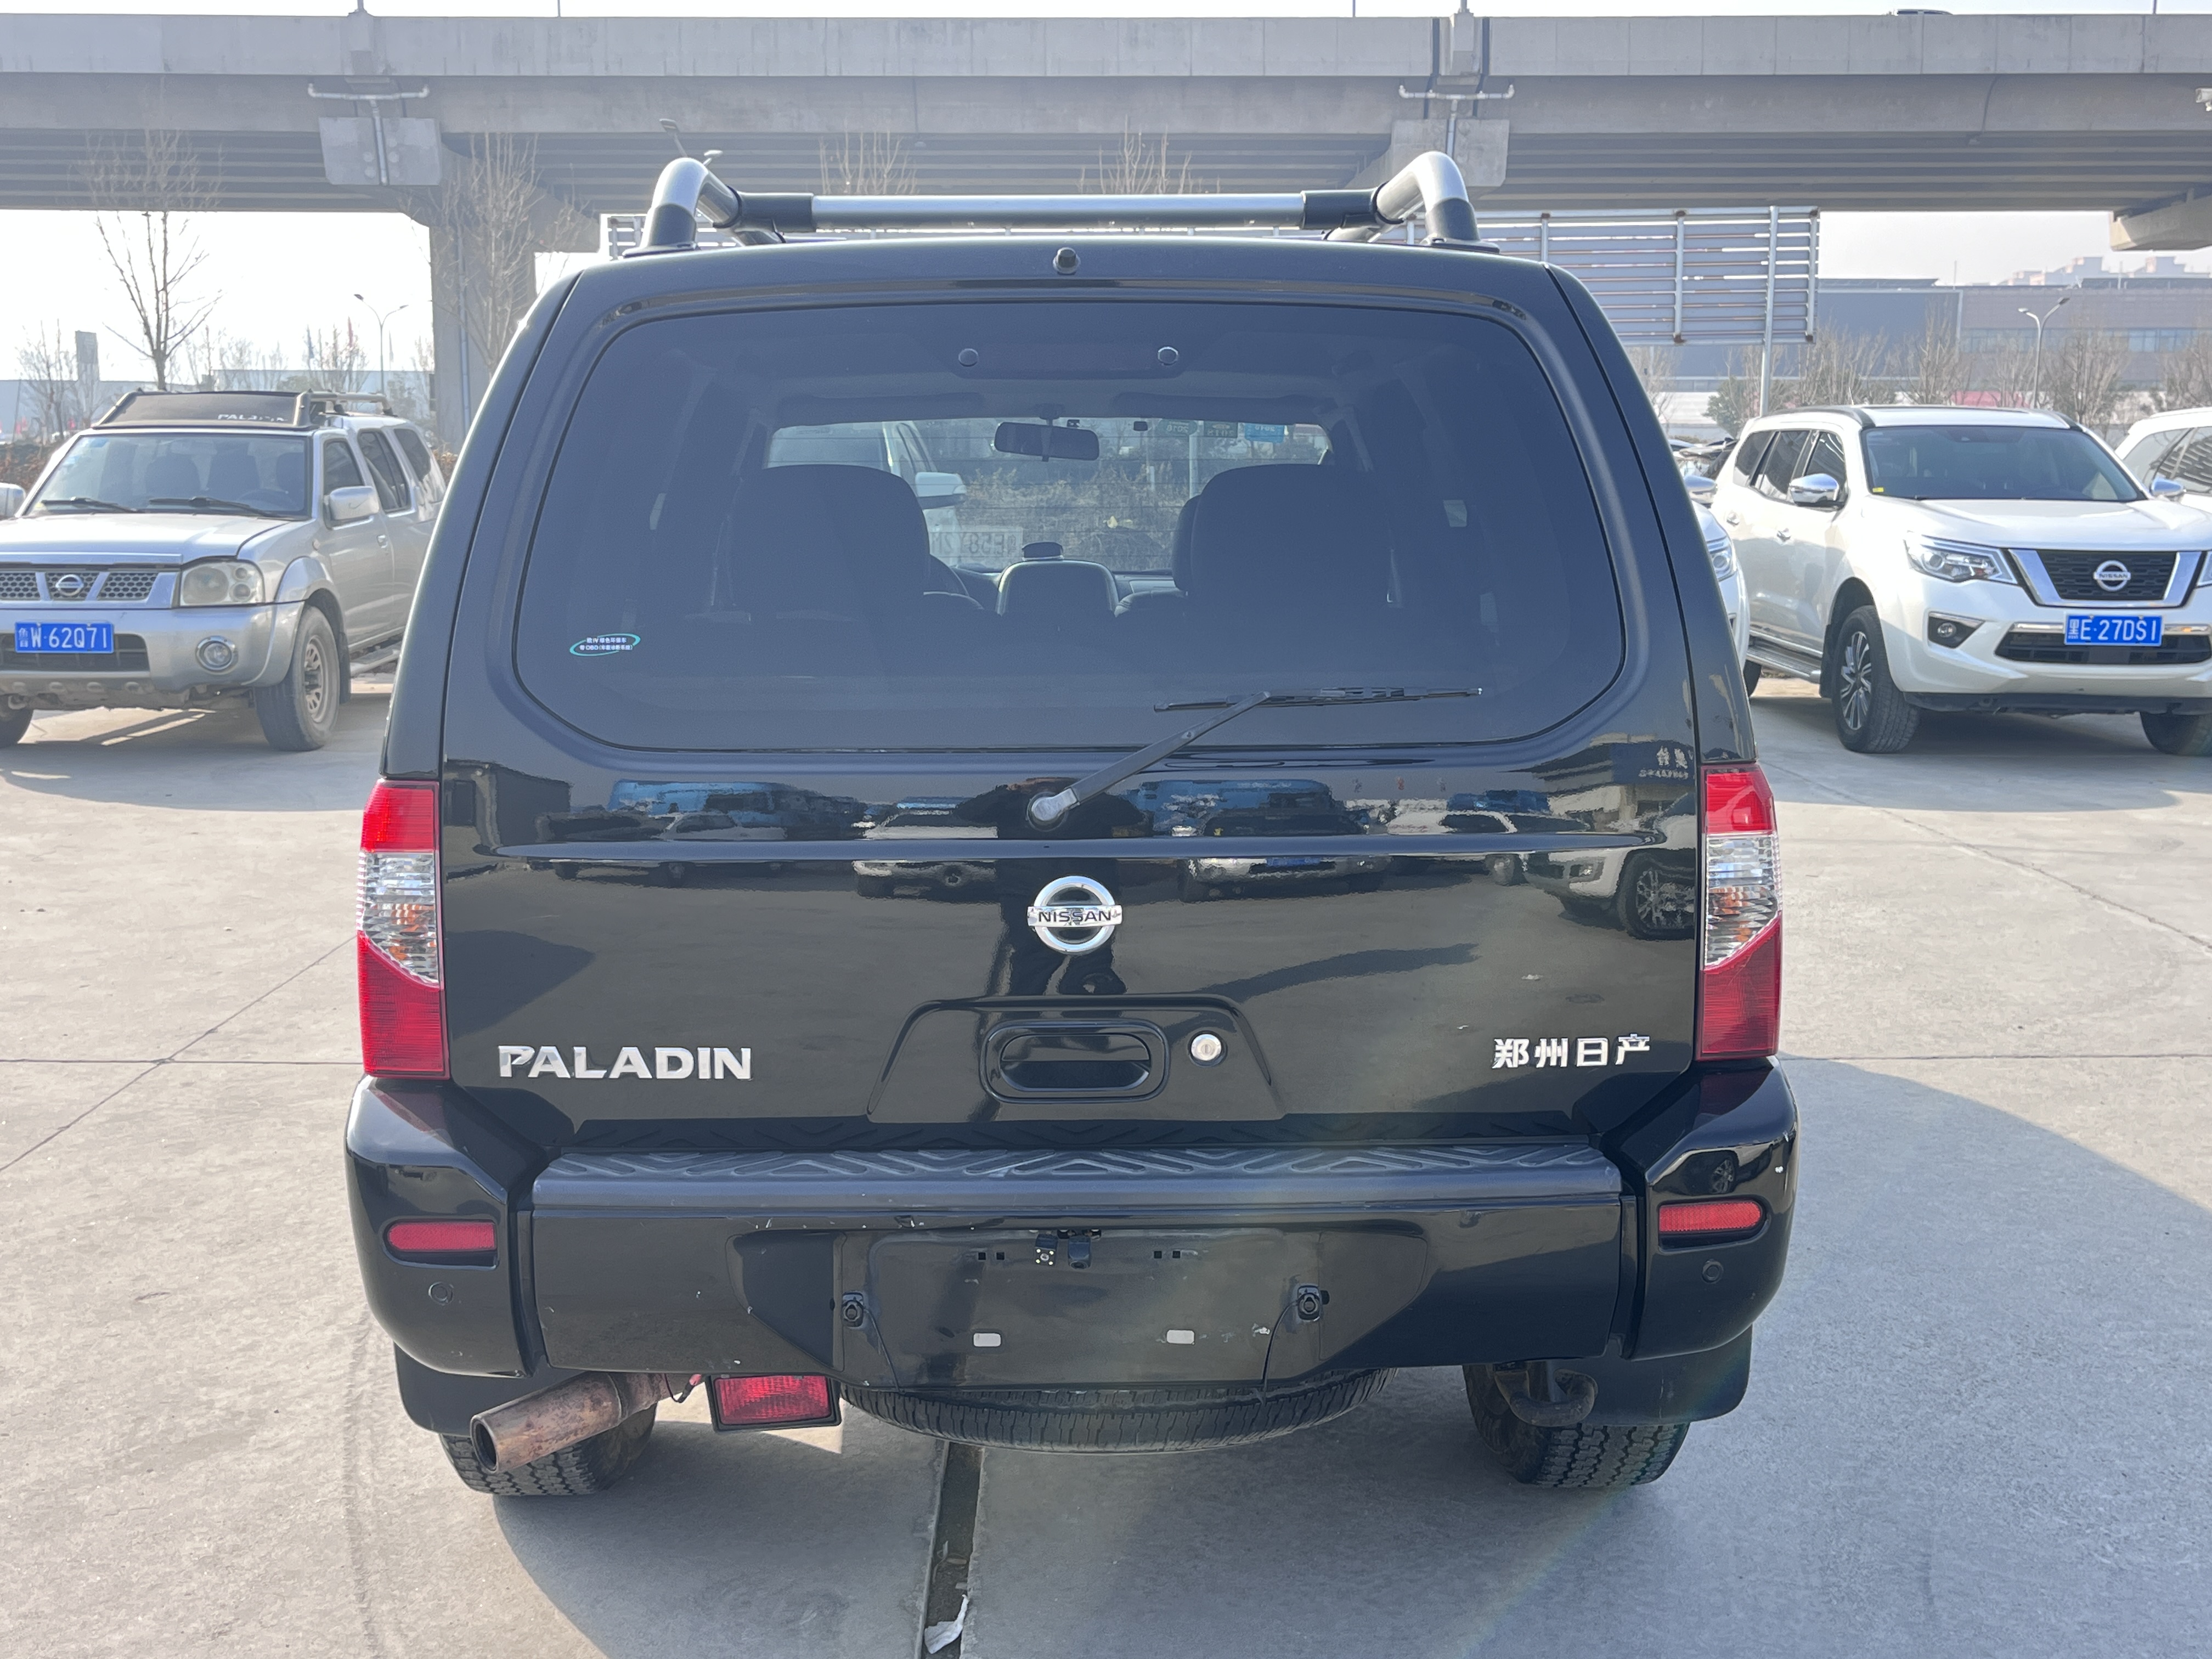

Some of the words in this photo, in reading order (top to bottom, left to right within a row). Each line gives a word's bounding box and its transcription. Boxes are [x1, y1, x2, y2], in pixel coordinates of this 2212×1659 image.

[1038, 910, 1111, 922] NISSAN
[498, 1045, 752, 1080] PALADIN
[1492, 1033, 1650, 1069] 郑州日产
